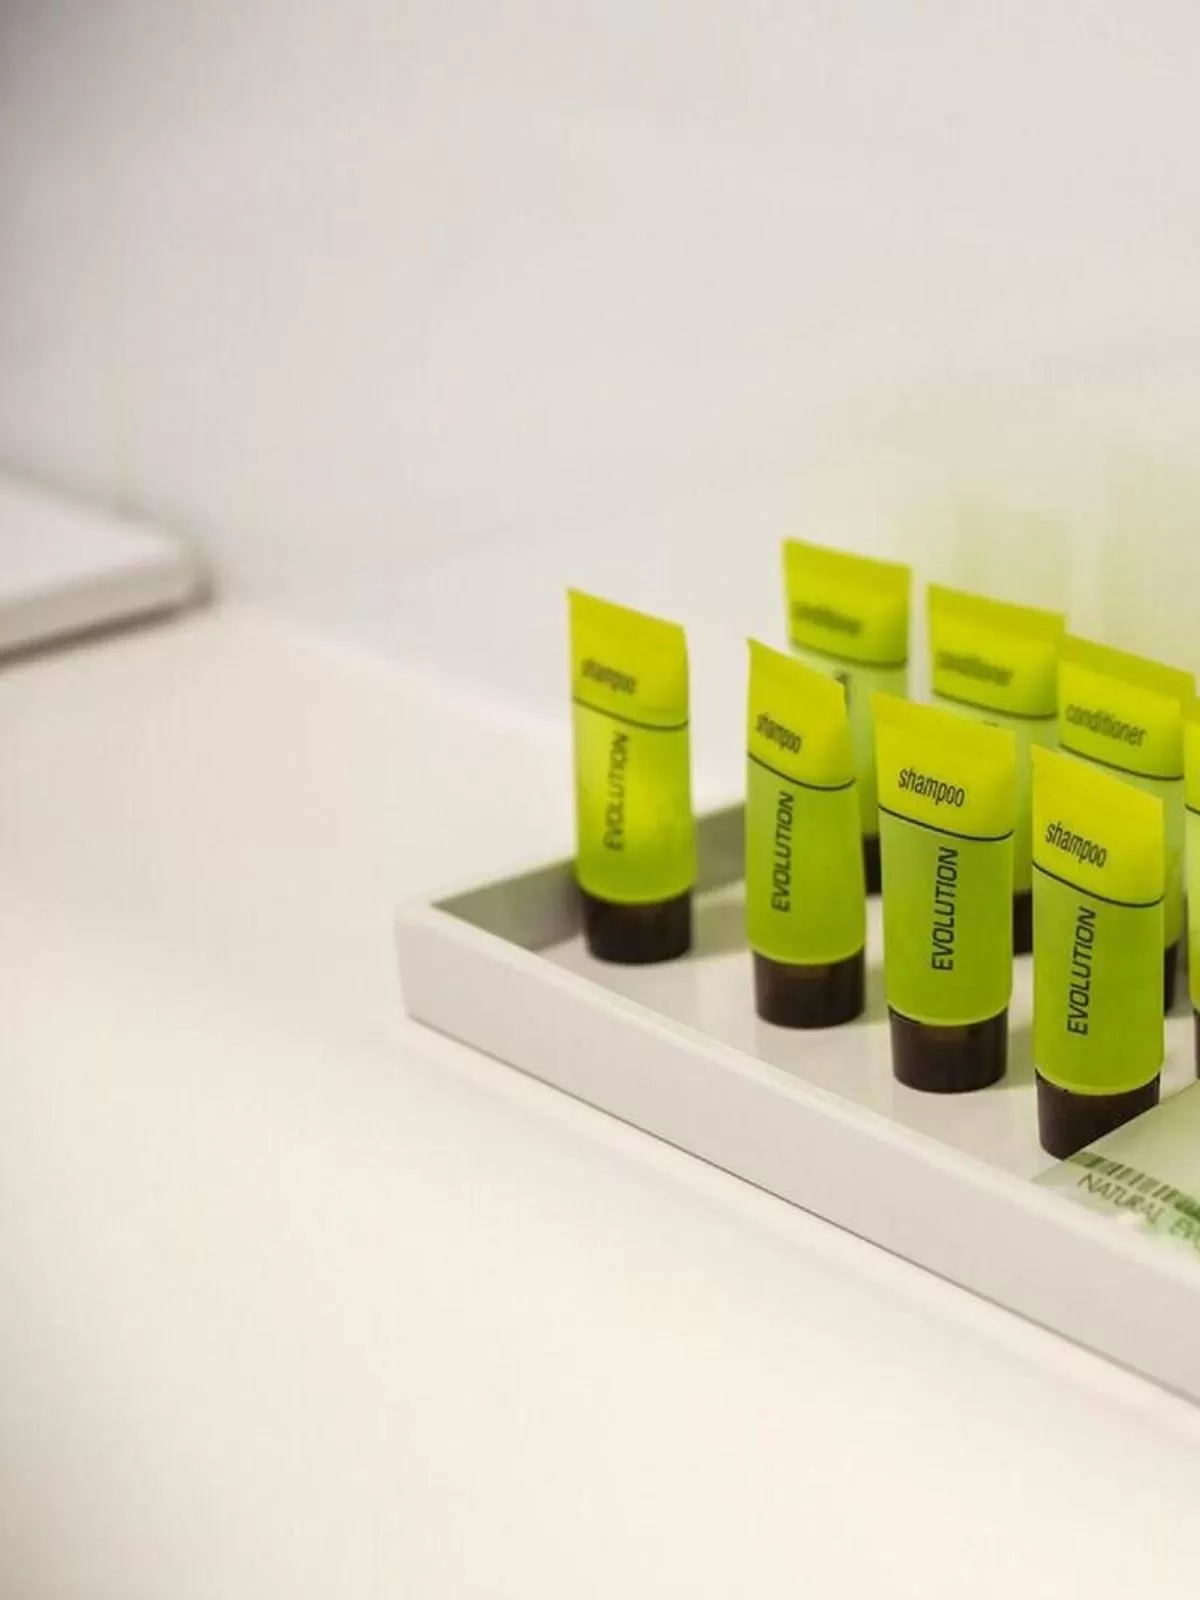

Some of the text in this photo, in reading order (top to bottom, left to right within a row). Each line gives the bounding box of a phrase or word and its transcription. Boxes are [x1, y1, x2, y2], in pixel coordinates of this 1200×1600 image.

[754, 711, 803, 755] shampoo
[1065, 702, 1147, 748] conditioner
[603, 731, 629, 852] EVOLUTION
[898, 766, 966, 808] shampoo
[771, 790, 794, 913] EVOLUTION
[1046, 822, 1107, 870] shampoo
[931, 846, 958, 972] EVOLUTION
[1067, 906, 1096, 1036] EVOLUTION
[1077, 1172, 1168, 1226] NATURAL
